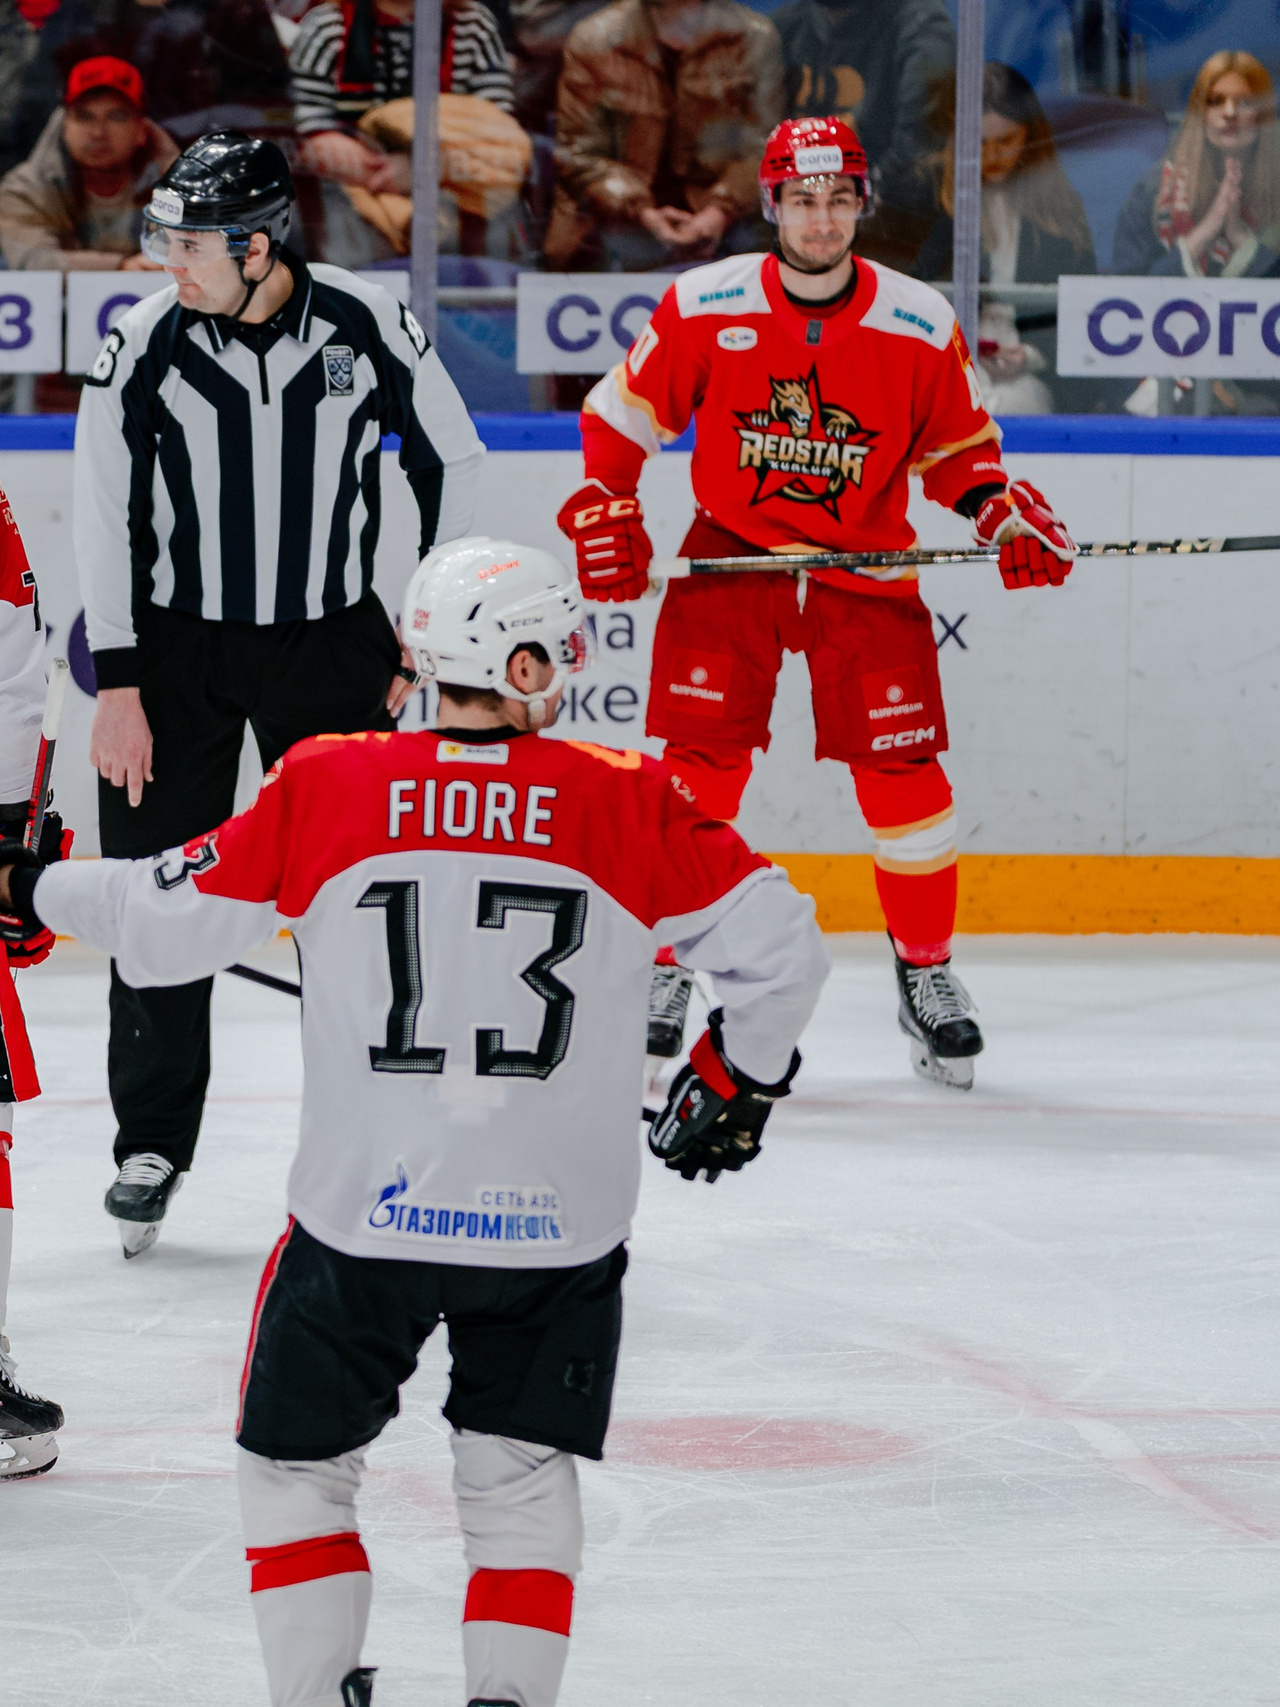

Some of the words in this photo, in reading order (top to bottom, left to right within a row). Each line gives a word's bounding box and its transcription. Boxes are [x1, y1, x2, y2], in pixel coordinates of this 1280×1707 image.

[1086, 297, 1280, 358] сог
[573, 499, 642, 530] CC
[870, 725, 936, 752] CCM
[388, 779, 557, 846] FIORE
[153, 832, 219, 890] 3
[356, 881, 587, 1079] 13
[481, 1190, 525, 1207] СЕТЬ
[397, 1204, 561, 1241] ГАЗПРОМНЕФТЬ
